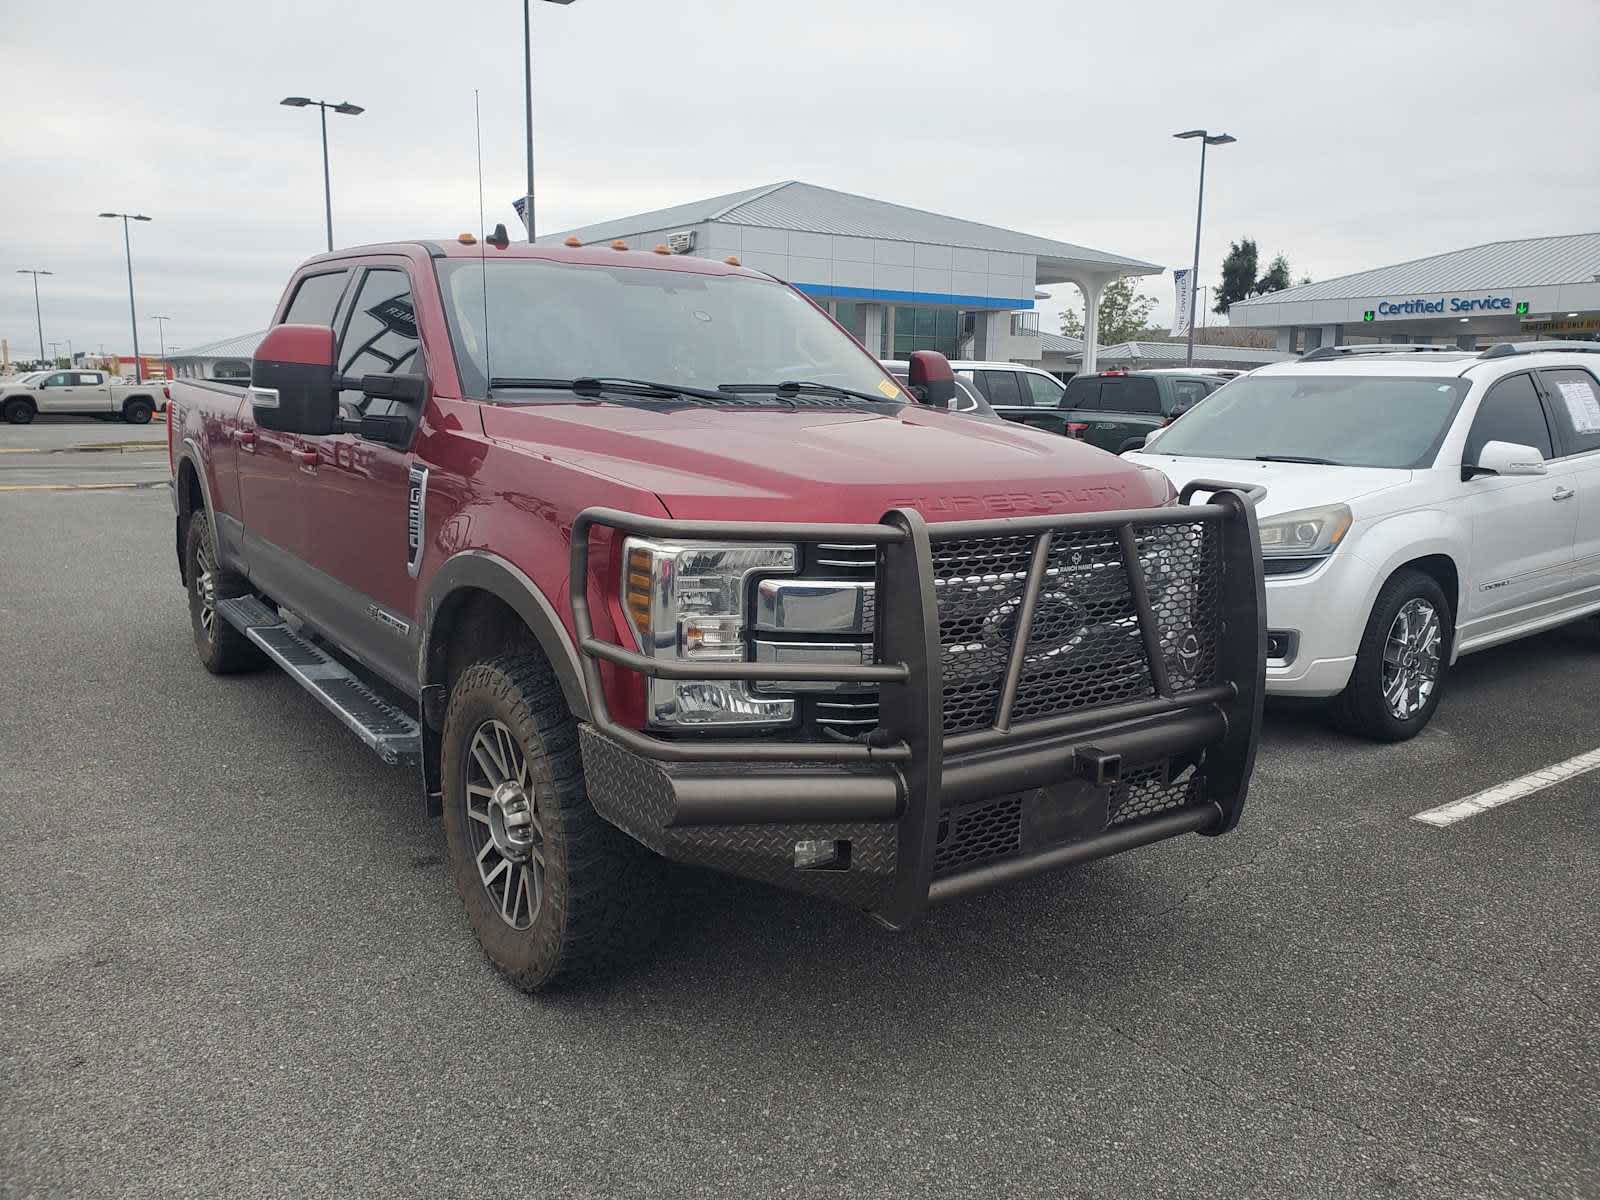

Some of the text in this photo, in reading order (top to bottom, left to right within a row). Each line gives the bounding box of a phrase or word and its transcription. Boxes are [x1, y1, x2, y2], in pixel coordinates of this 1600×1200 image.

[1378, 294, 1512, 316] Certified Service
[893, 482, 1126, 514] SUPER DUTY
